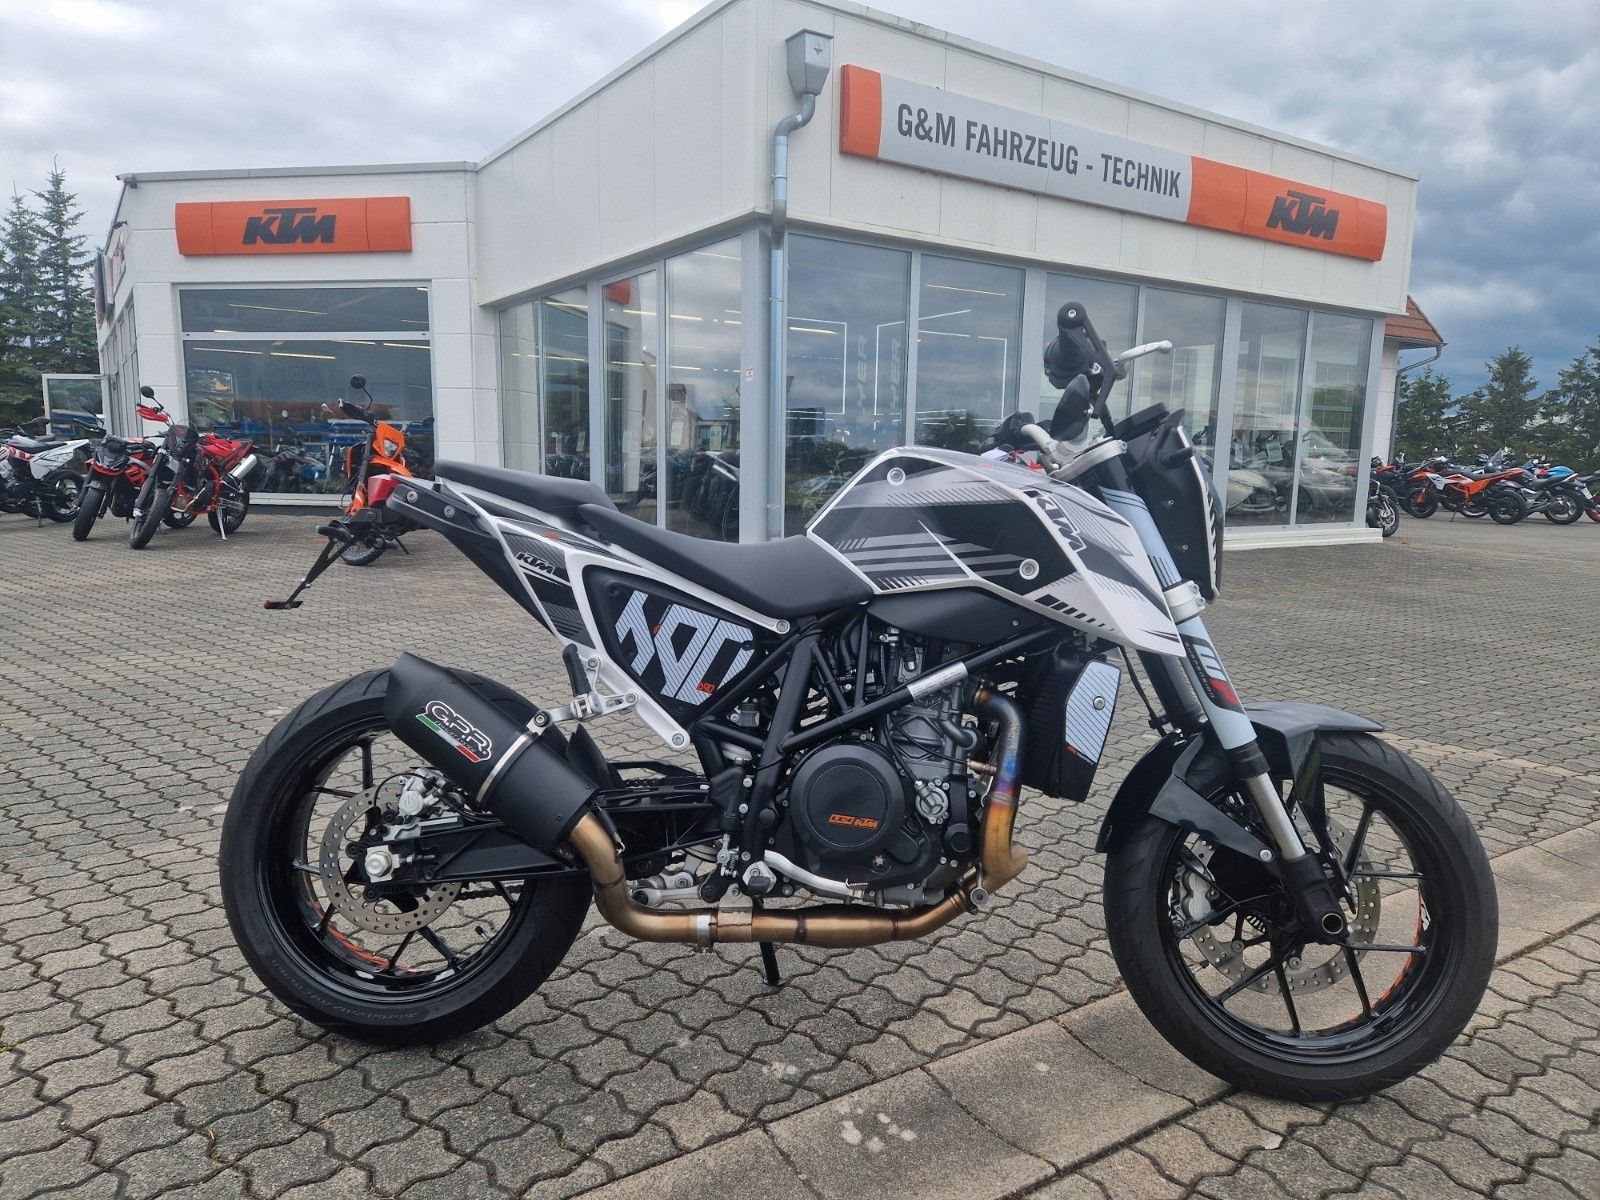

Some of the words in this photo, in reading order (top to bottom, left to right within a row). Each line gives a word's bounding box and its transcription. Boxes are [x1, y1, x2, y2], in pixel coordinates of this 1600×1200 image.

[896, 103, 957, 148] G&M
[966, 119, 1079, 176] FAHRZEUG
[1100, 153, 1181, 199] TECHNIK
[242, 207, 337, 245] KTM
[1265, 189, 1340, 241] KTM
[1023, 489, 1087, 552] KTM
[515, 552, 556, 574] KTM
